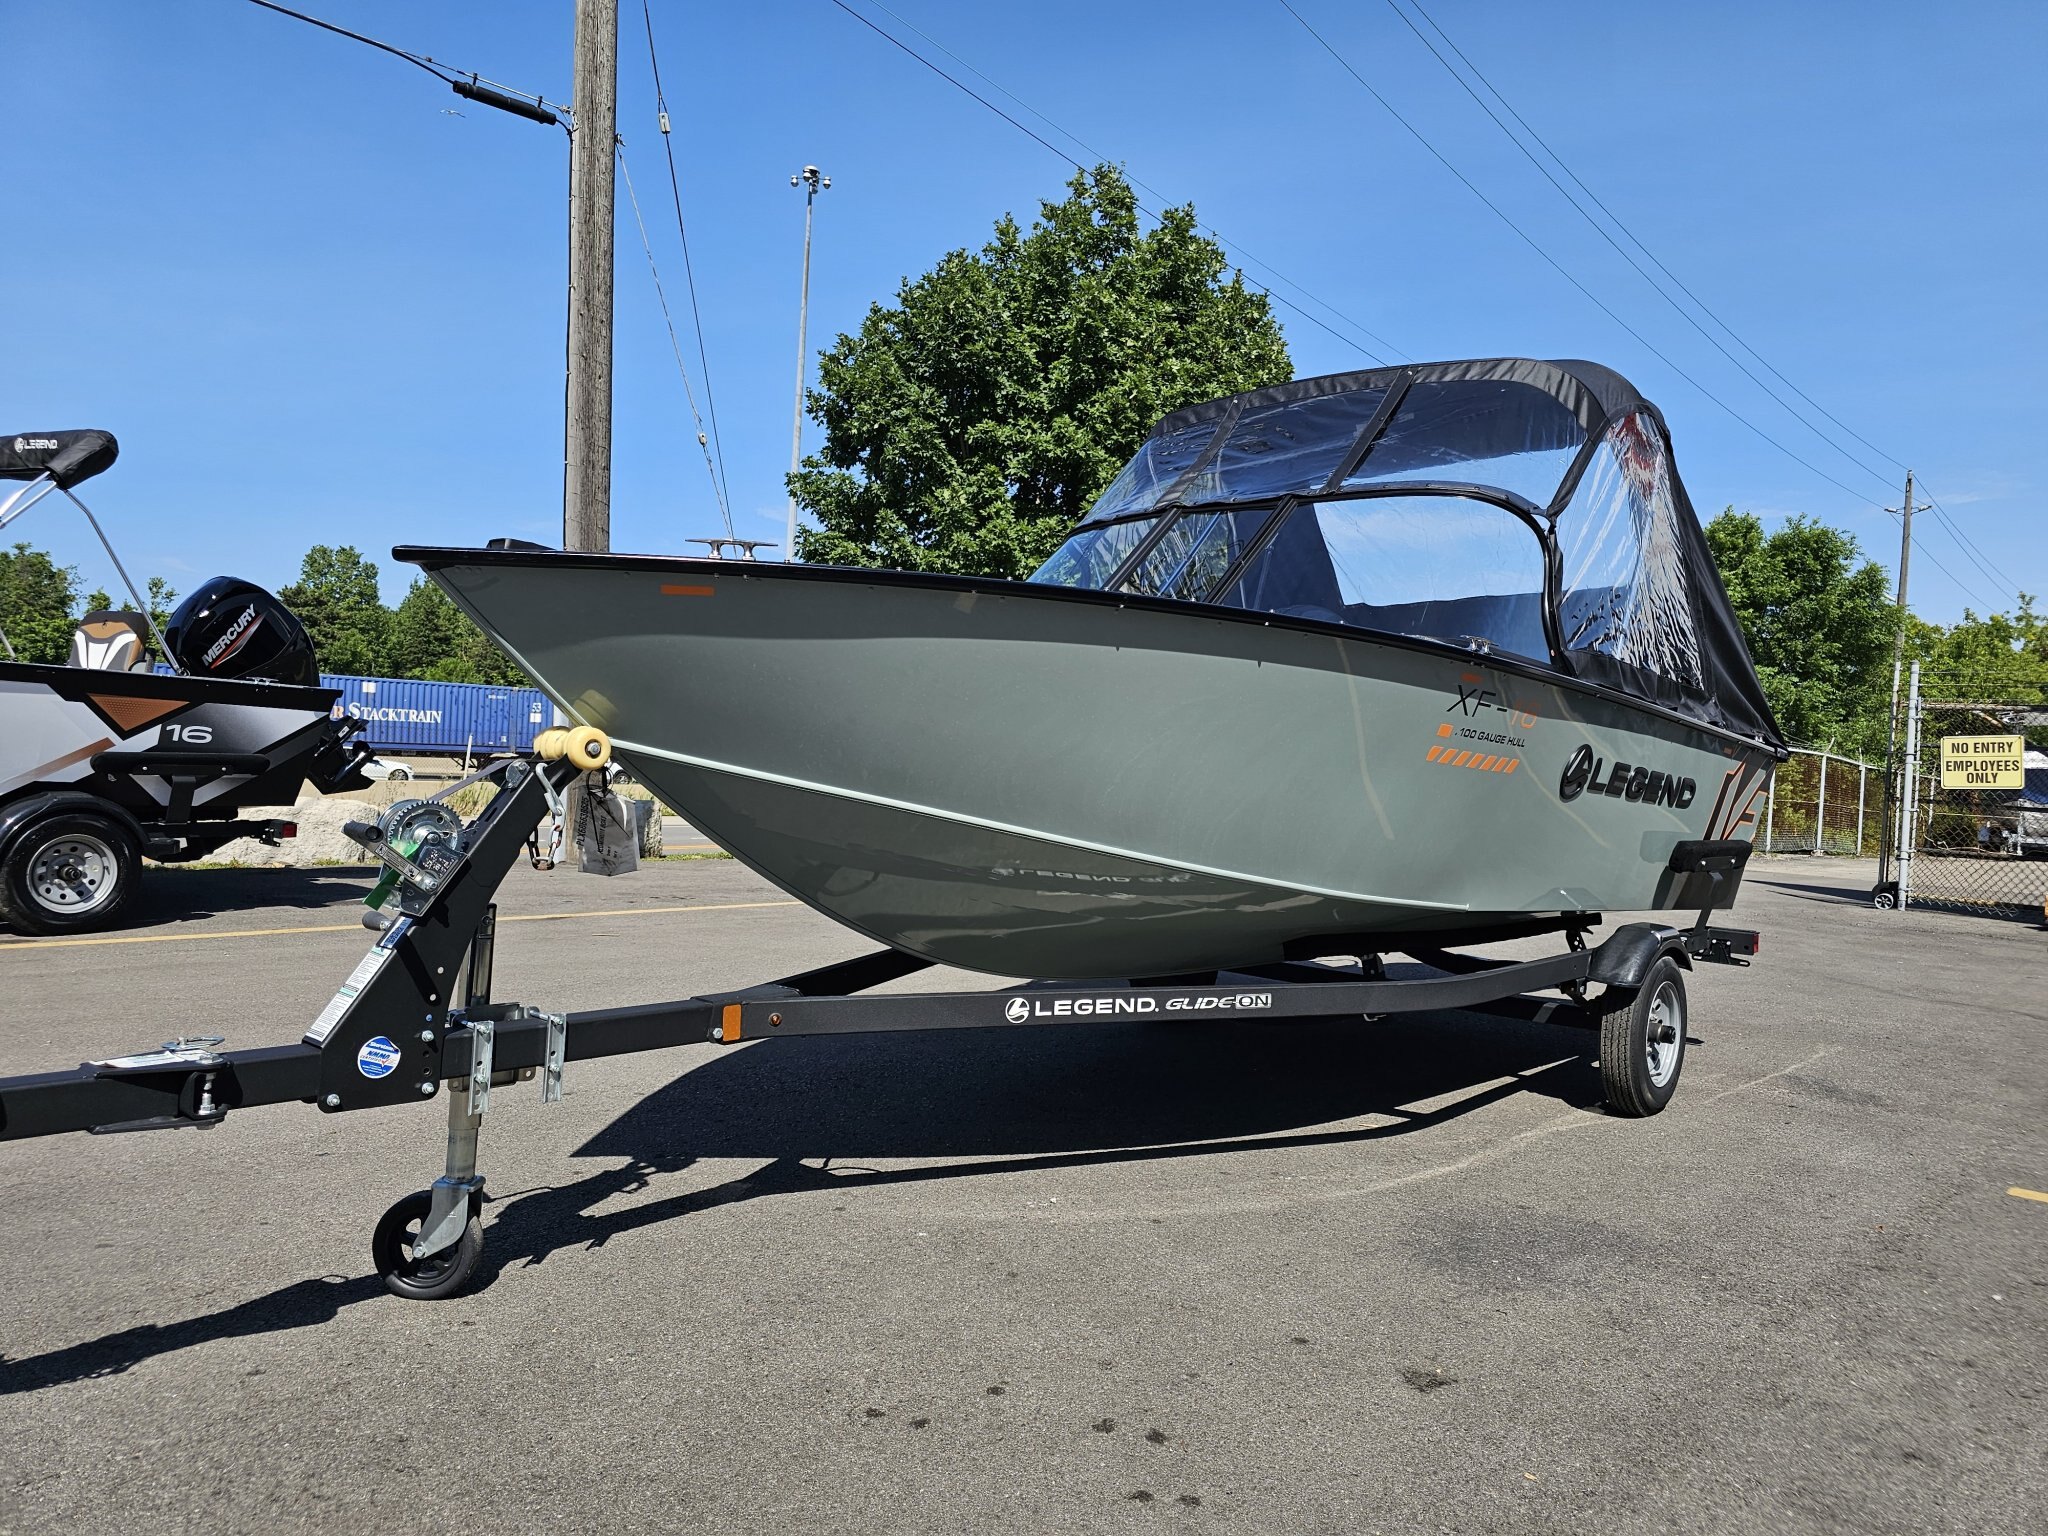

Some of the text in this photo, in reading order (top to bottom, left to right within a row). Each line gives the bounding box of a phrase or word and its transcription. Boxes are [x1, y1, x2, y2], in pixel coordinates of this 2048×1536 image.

[201, 603, 256, 667] MERCURY
[348, 701, 442, 724] STACKTRAIN
[532, 702, 541, 713] 53
[166, 724, 213, 744] 16
[1477, 731, 1507, 745] GAUGE
[1506, 736, 1526, 748] HULL
[1951, 741, 2014, 754] NO ENTRY
[1945, 760, 2020, 772] EMPLOYEES
[1587, 757, 1697, 810] LEGEND
[1966, 772, 1999, 784] ONLY
